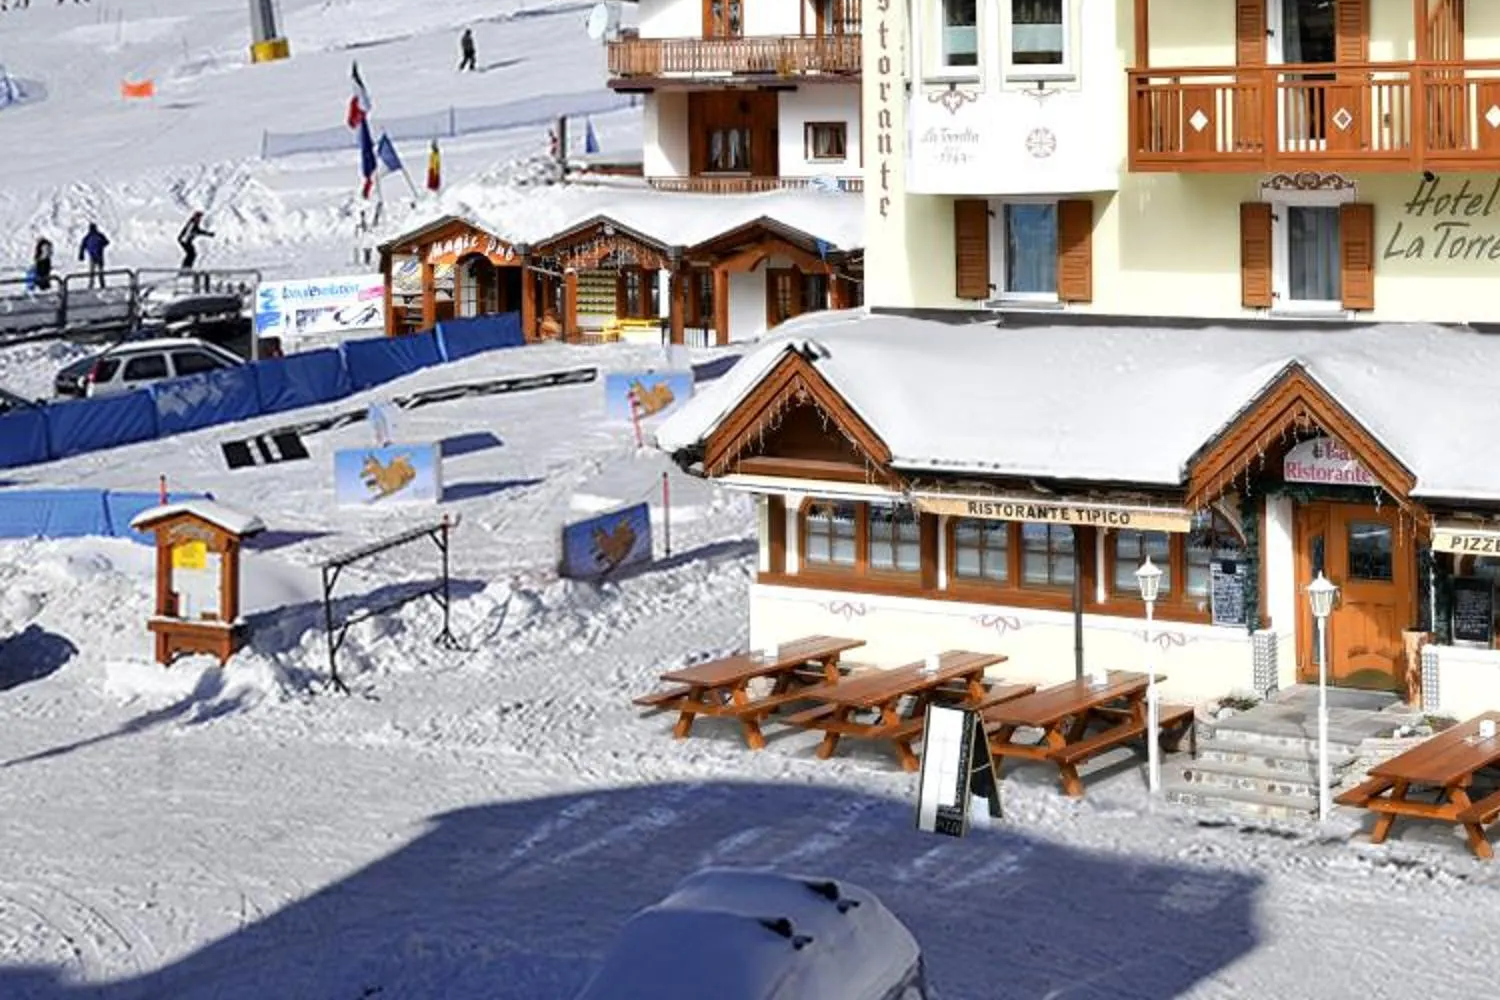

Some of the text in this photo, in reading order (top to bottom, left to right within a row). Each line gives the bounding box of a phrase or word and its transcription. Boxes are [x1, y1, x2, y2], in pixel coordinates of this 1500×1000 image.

[1384, 221, 1426, 260] La
[1286, 461, 1373, 483] Ristorante
[968, 501, 1070, 521] RISTORANTE
